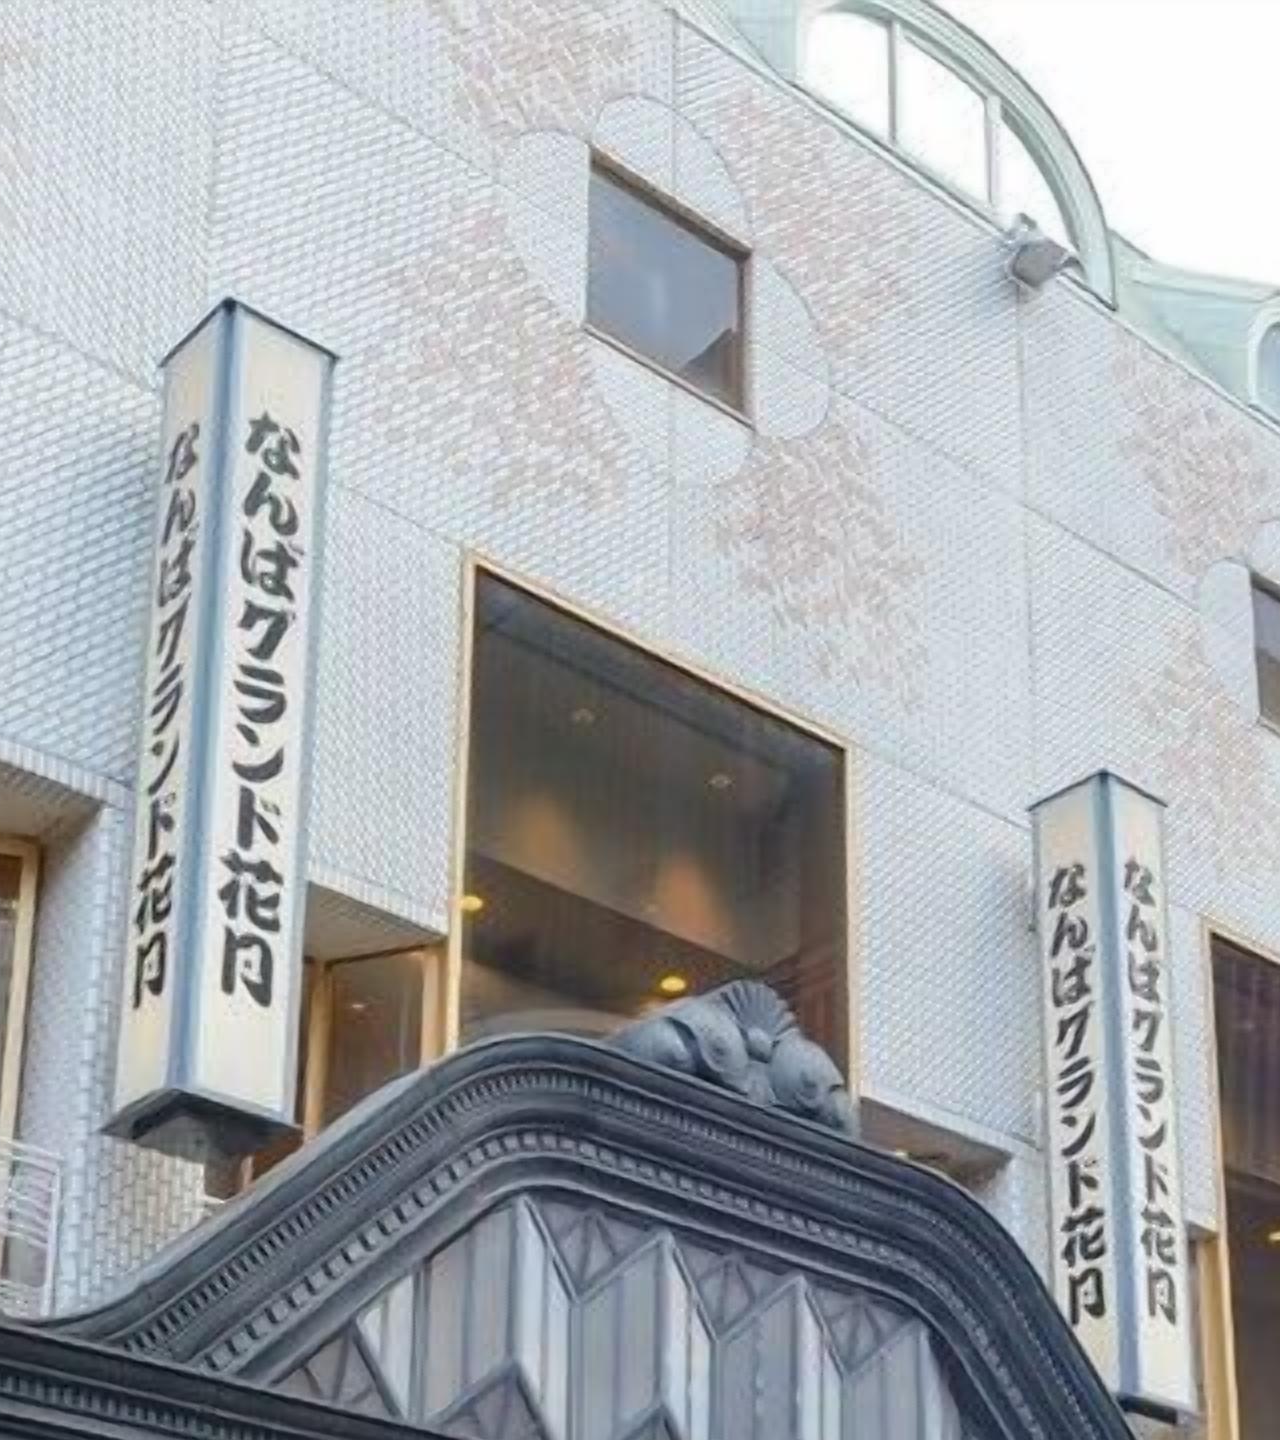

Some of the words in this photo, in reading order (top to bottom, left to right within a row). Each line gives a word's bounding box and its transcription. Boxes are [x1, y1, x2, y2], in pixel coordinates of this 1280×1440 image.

[132, 423, 199, 1008] なんばグランド花月
[217, 411, 304, 1009] なんばグランド花月
[1049, 863, 1107, 1326] なんばグランド花月
[1124, 858, 1177, 1325] なんばグランド花月
